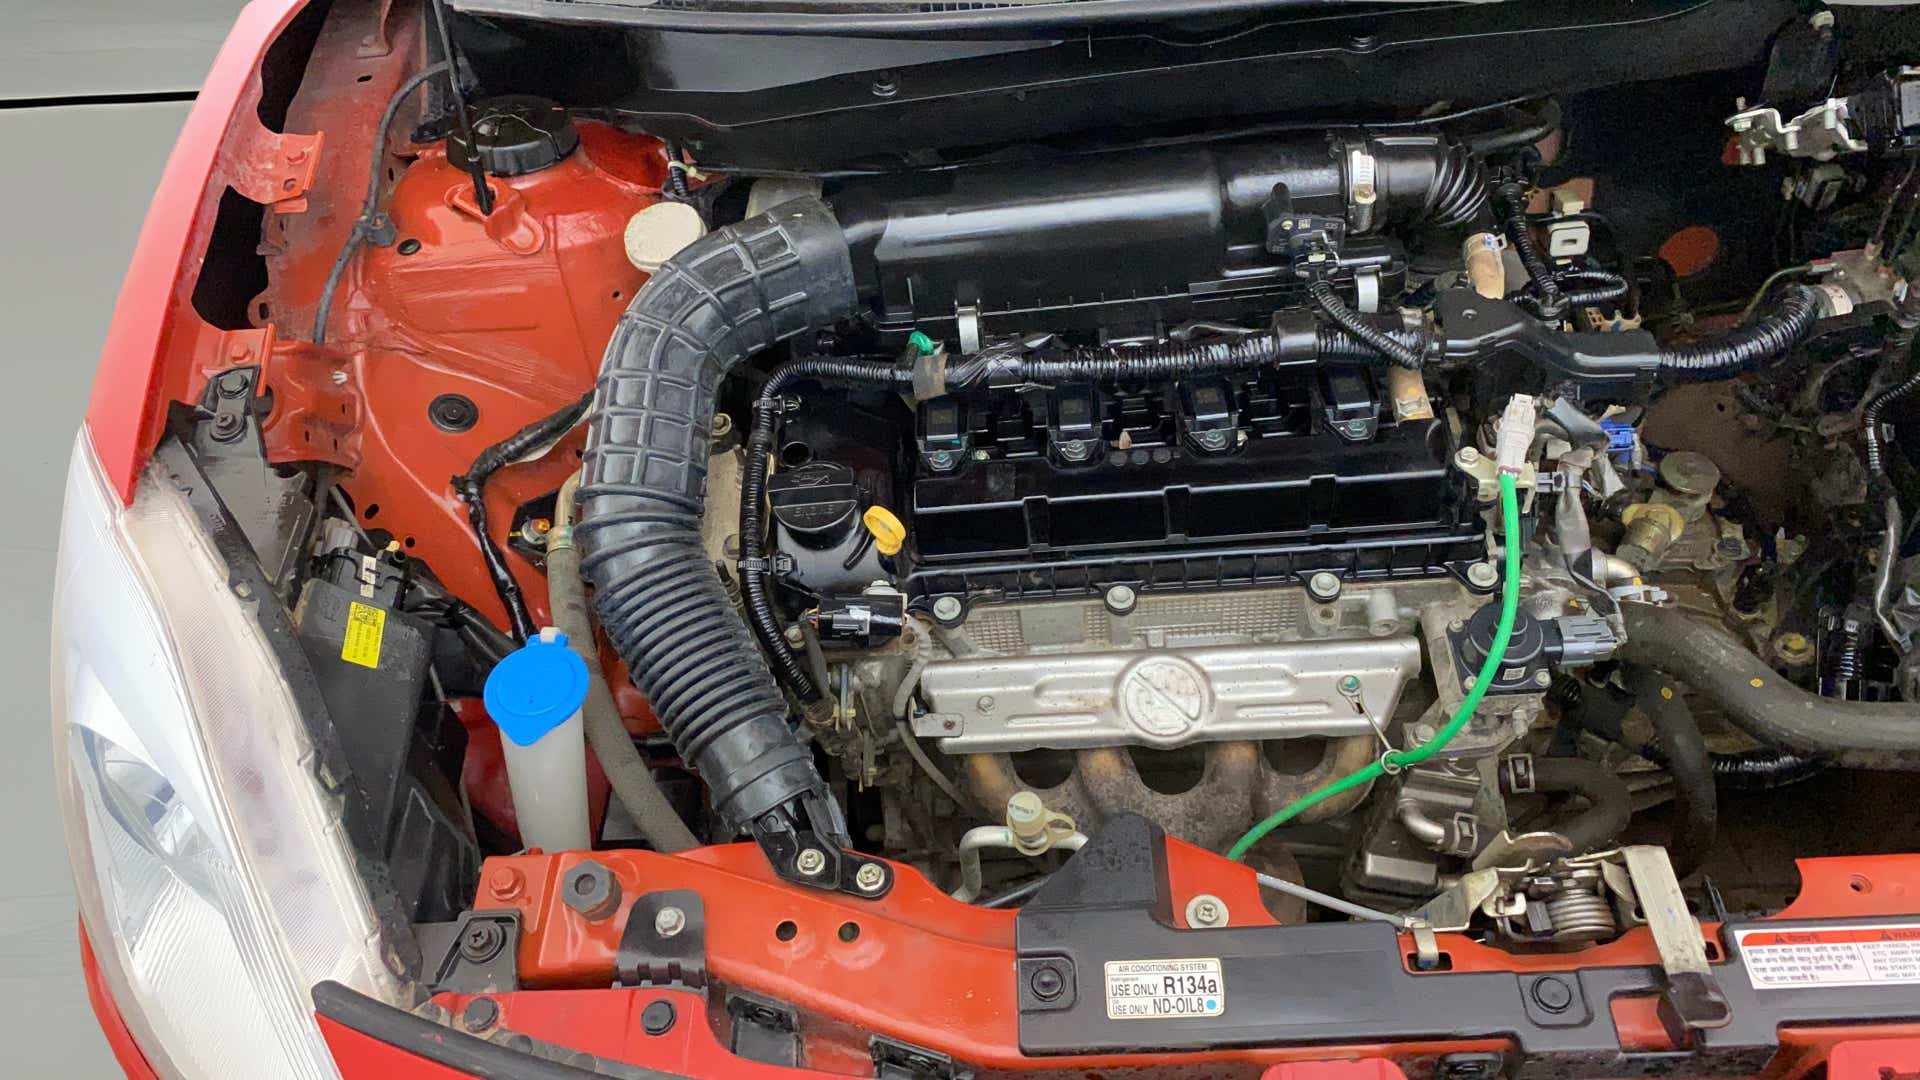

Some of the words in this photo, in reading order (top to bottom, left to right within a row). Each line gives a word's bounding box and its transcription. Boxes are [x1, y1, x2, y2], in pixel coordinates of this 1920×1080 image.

[1118, 965, 1130, 973] AIR
[1130, 964, 1179, 972] CONDITIONING
[1180, 963, 1208, 971] SYSTEM
[1111, 984, 1130, 997] USE
[1133, 983, 1158, 996] ONLY
[1163, 975, 1218, 994] R134a
[1112, 1005, 1127, 1015] USE
[1129, 1004, 1149, 1015] ONLY
[1153, 997, 1205, 1014] ND-OIL8
